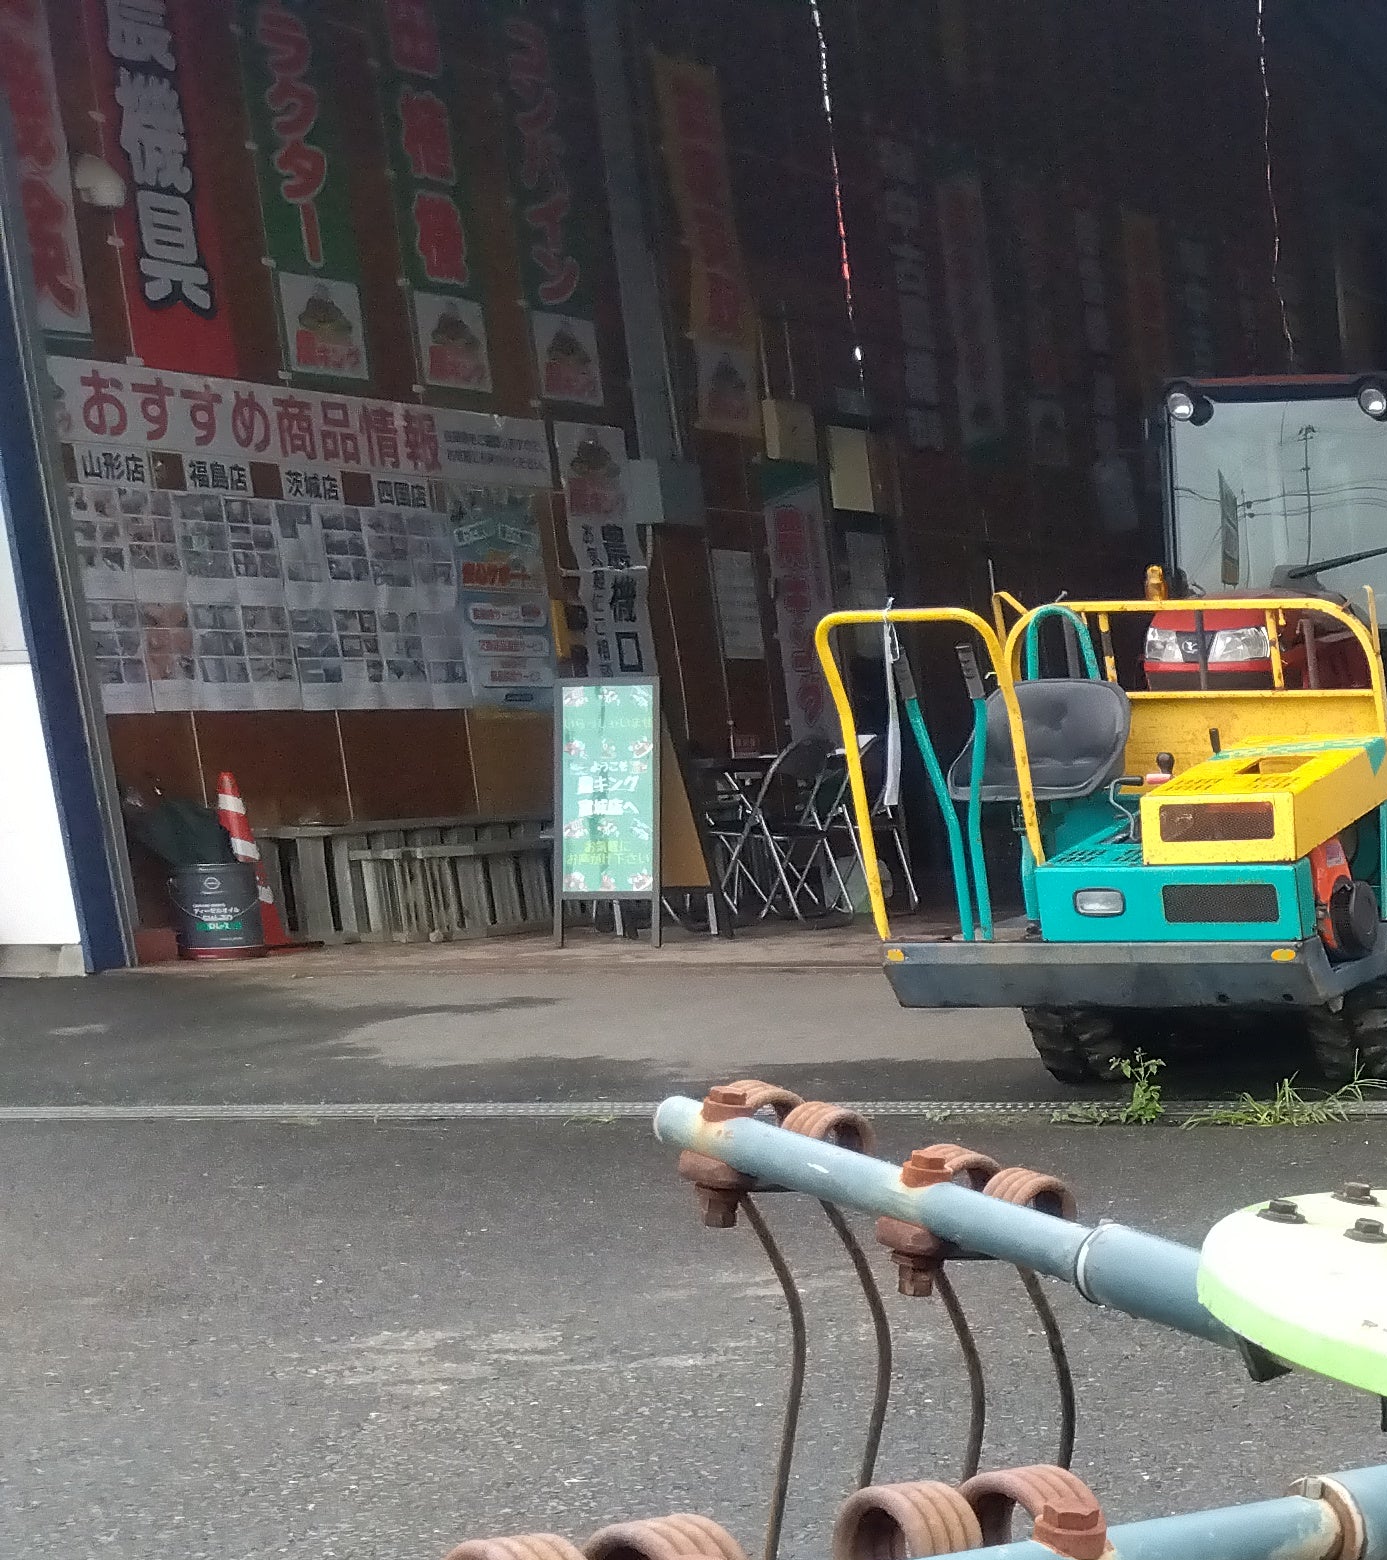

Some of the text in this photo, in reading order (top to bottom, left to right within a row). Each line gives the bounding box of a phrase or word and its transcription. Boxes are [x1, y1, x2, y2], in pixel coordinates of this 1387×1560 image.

[80, 369, 442, 472] おすすめ商品情報
[81, 450, 145, 484] 山形店
[188, 460, 248, 492] 福島店
[284, 469, 339, 501] 茨城店
